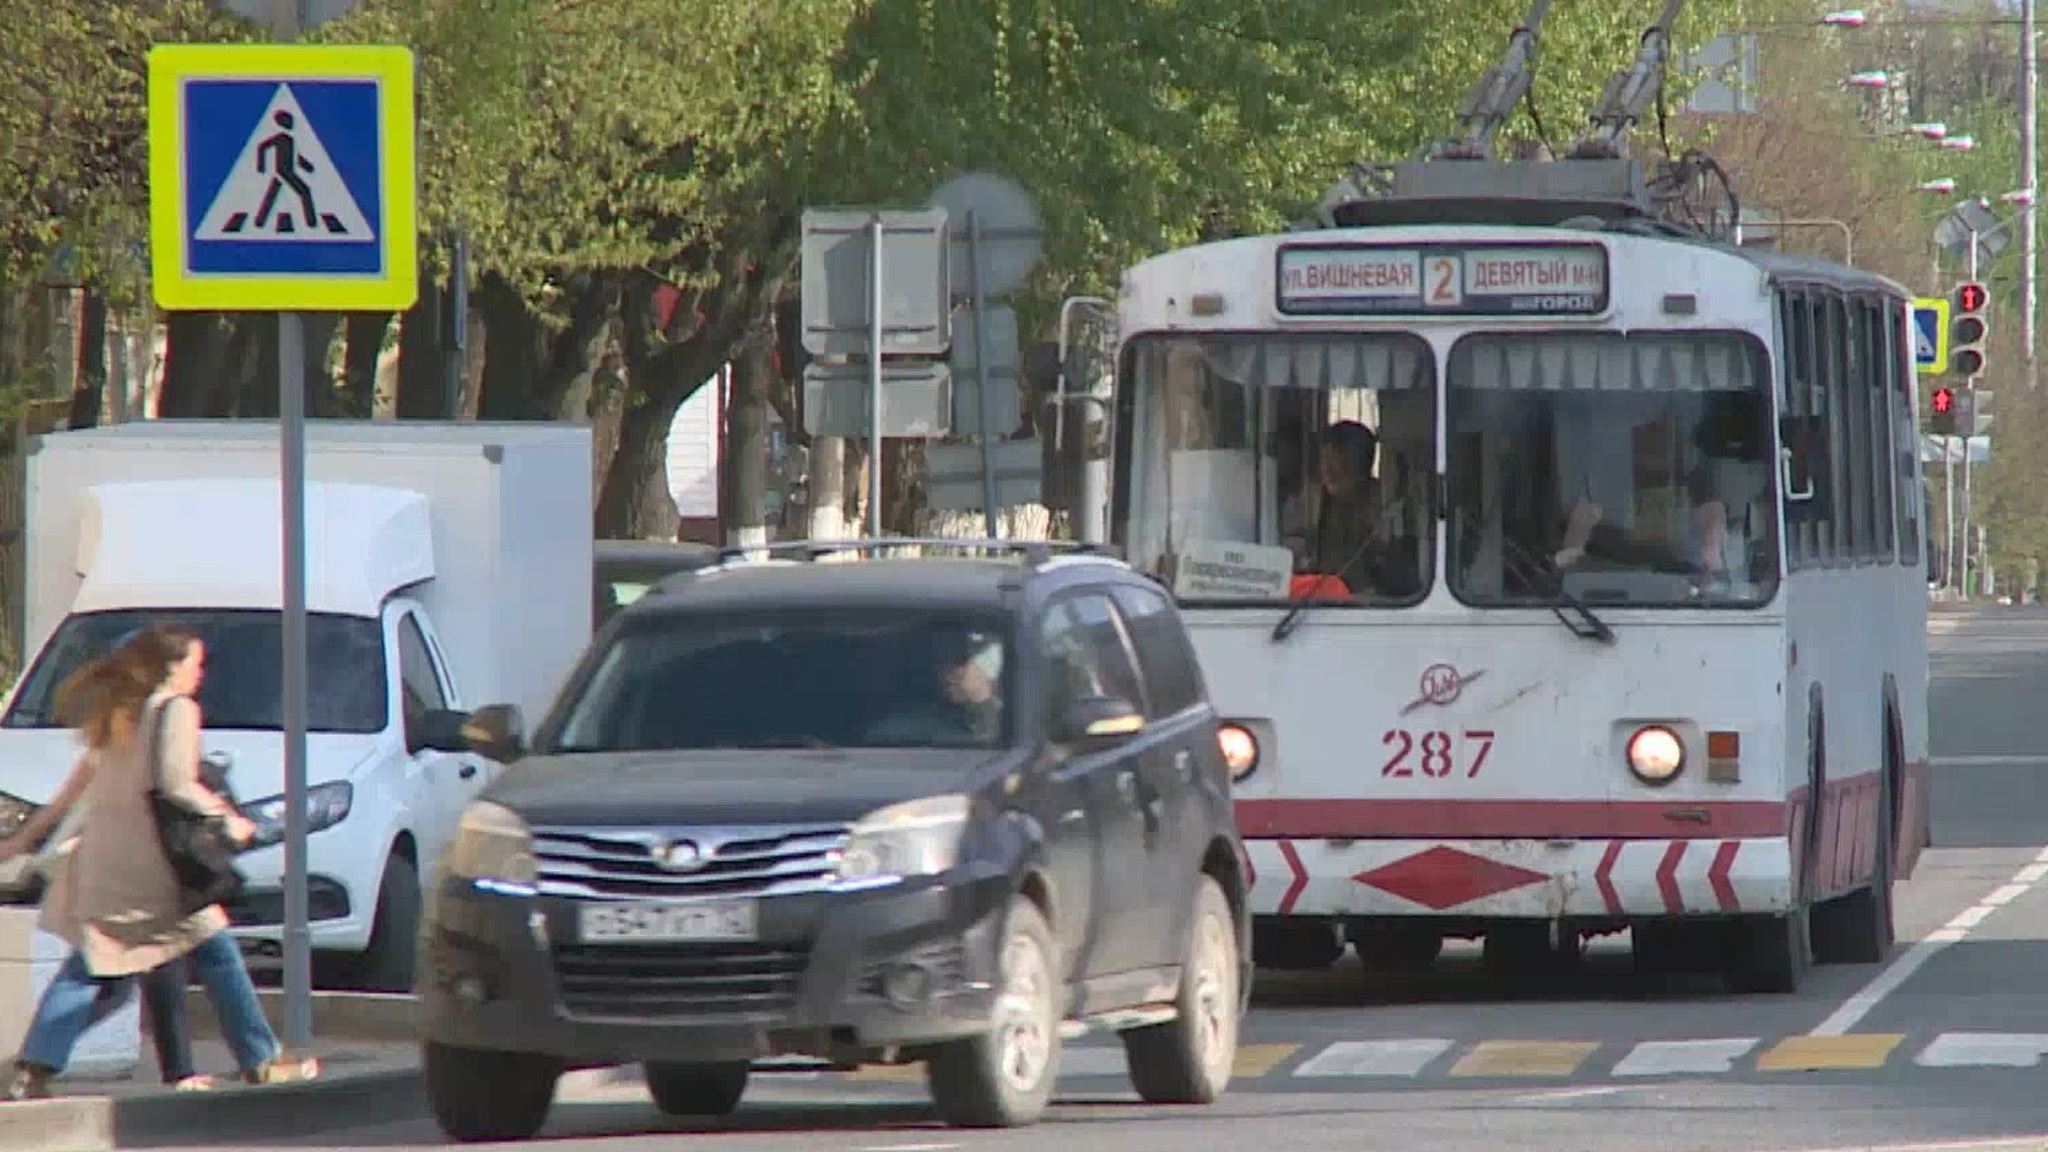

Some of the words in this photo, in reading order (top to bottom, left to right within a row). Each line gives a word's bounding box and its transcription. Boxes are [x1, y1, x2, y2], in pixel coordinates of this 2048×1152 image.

[1433, 258, 1454, 301] 2
[1474, 256, 1568, 288] ДЕВЯТЫЙ
[1381, 729, 1495, 779] 287
